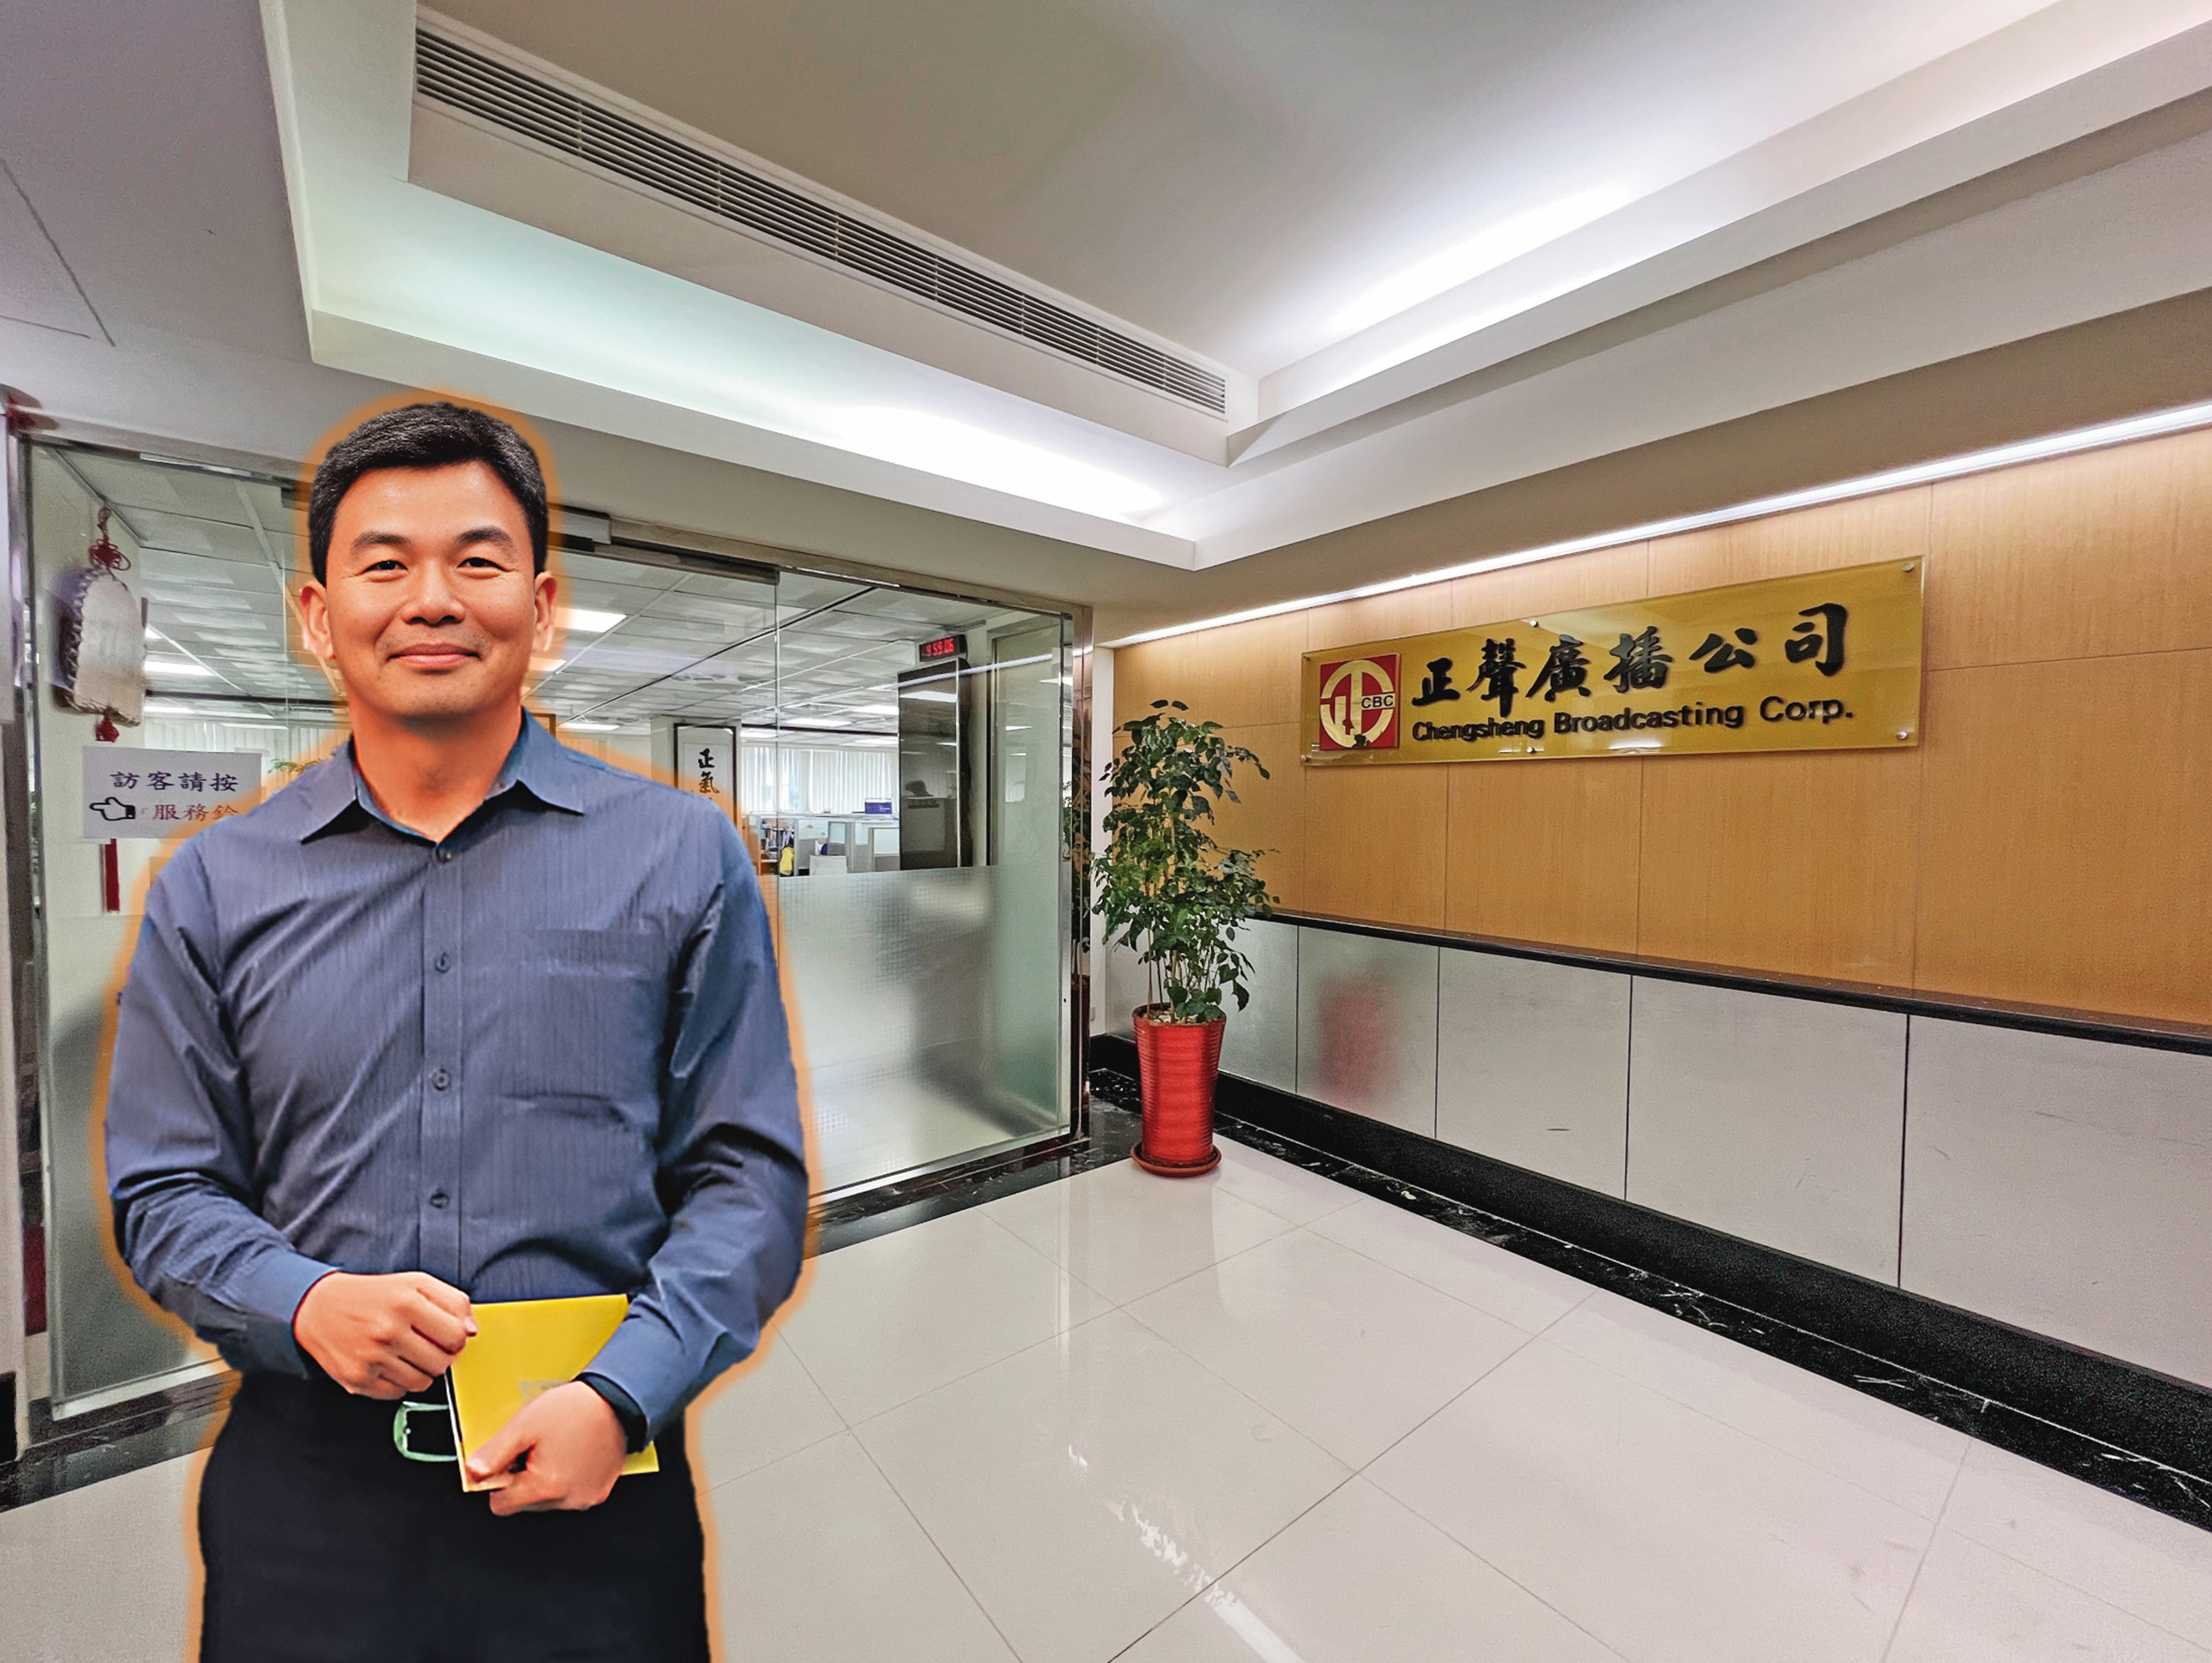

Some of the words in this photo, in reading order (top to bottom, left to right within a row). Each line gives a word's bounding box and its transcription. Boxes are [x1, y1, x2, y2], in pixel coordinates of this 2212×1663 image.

[1411, 602, 1849, 718] 正聲廣播公司
[1361, 695, 1394, 709] CBC
[1412, 717, 1545, 741] Chengsheng
[1554, 701, 1745, 734] Broadcasting
[1760, 696, 1853, 724] Corp.
[110, 771, 238, 792] 訪客請按
[698, 747, 720, 800] 正氣
